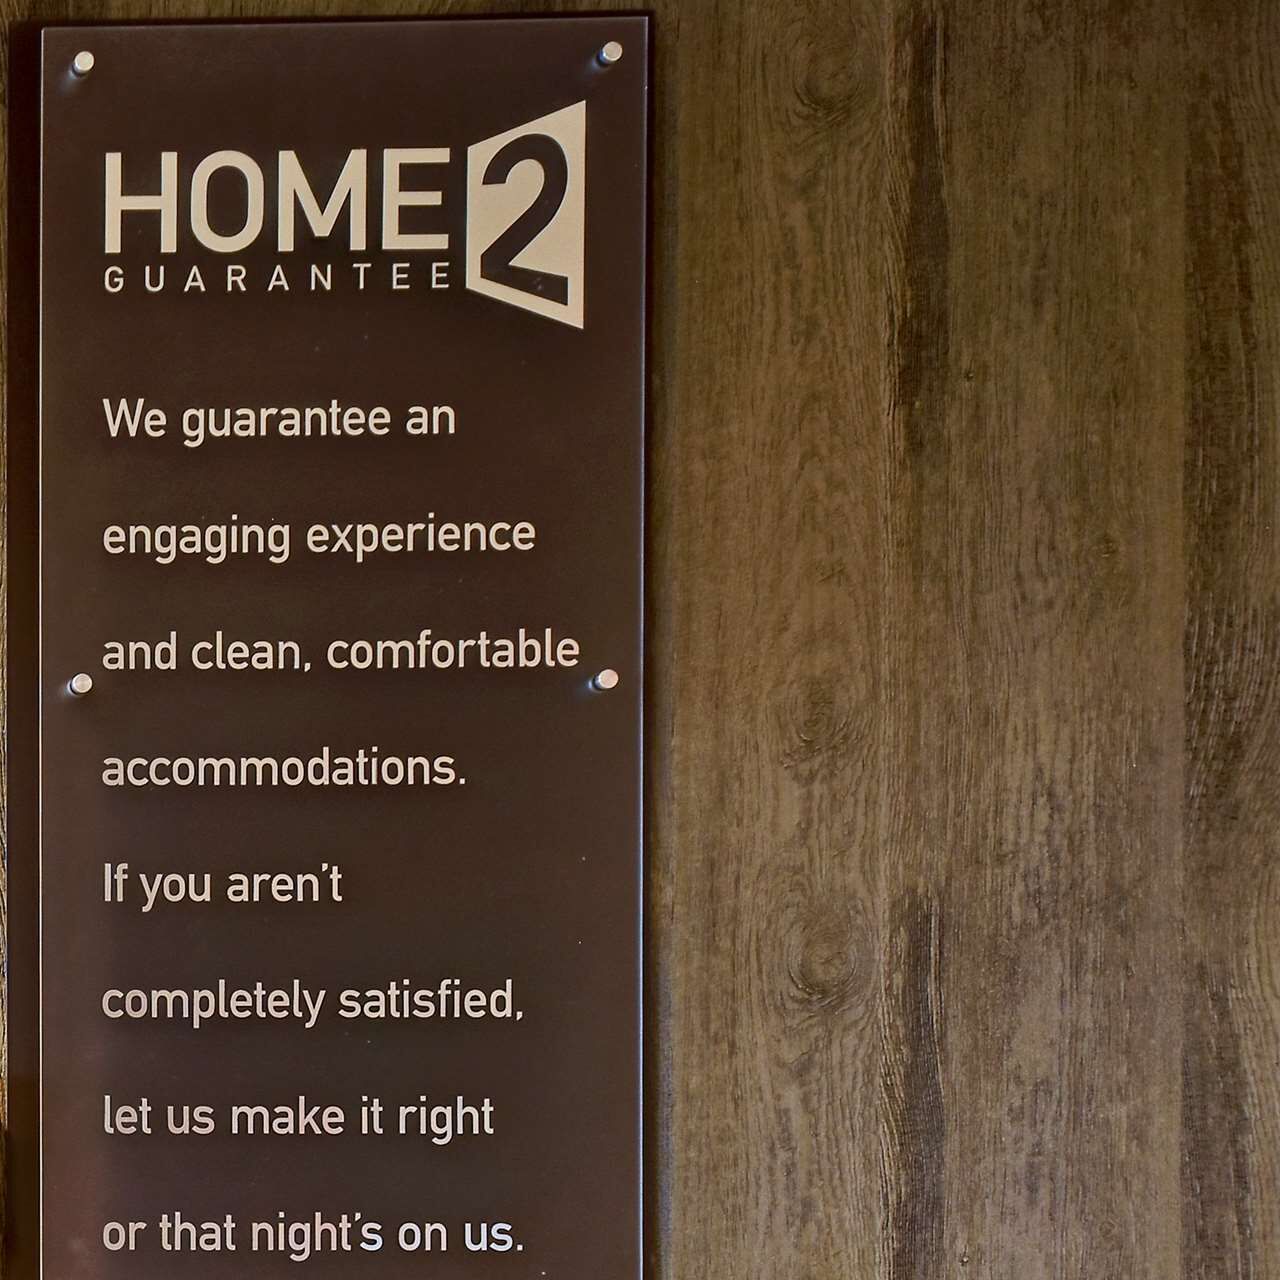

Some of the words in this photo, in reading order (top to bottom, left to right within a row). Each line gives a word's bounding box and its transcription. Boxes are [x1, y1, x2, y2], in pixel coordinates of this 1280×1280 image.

[105, 148, 450, 253] HOME
[480, 133, 568, 306] 2
[105, 262, 449, 292] GUARANTEE
[103, 398, 166, 438] We
[183, 400, 390, 447] guarantee
[407, 406, 454, 434] an
[104, 514, 289, 564] engaging
[307, 513, 535, 562] experience
[103, 631, 176, 669] and
[192, 631, 310, 672] clean,
[328, 628, 579, 668] comfortable
[102, 747, 465, 785] accommodations.
[105, 863, 128, 901] If
[140, 874, 210, 912] you
[227, 863, 342, 901] aren't
[103, 979, 326, 1028] completely
[339, 979, 522, 1022] satisfied,
[105, 1095, 151, 1134] let
[168, 1106, 214, 1134] us
[232, 1096, 344, 1134] make
[362, 1096, 383, 1134] it
[400, 1096, 493, 1145] right
[103, 1222, 147, 1250] or
[160, 1212, 235, 1250] that
[252, 1212, 382, 1261] night's
[399, 1223, 446, 1250] on
[465, 1223, 522, 1251] us.
